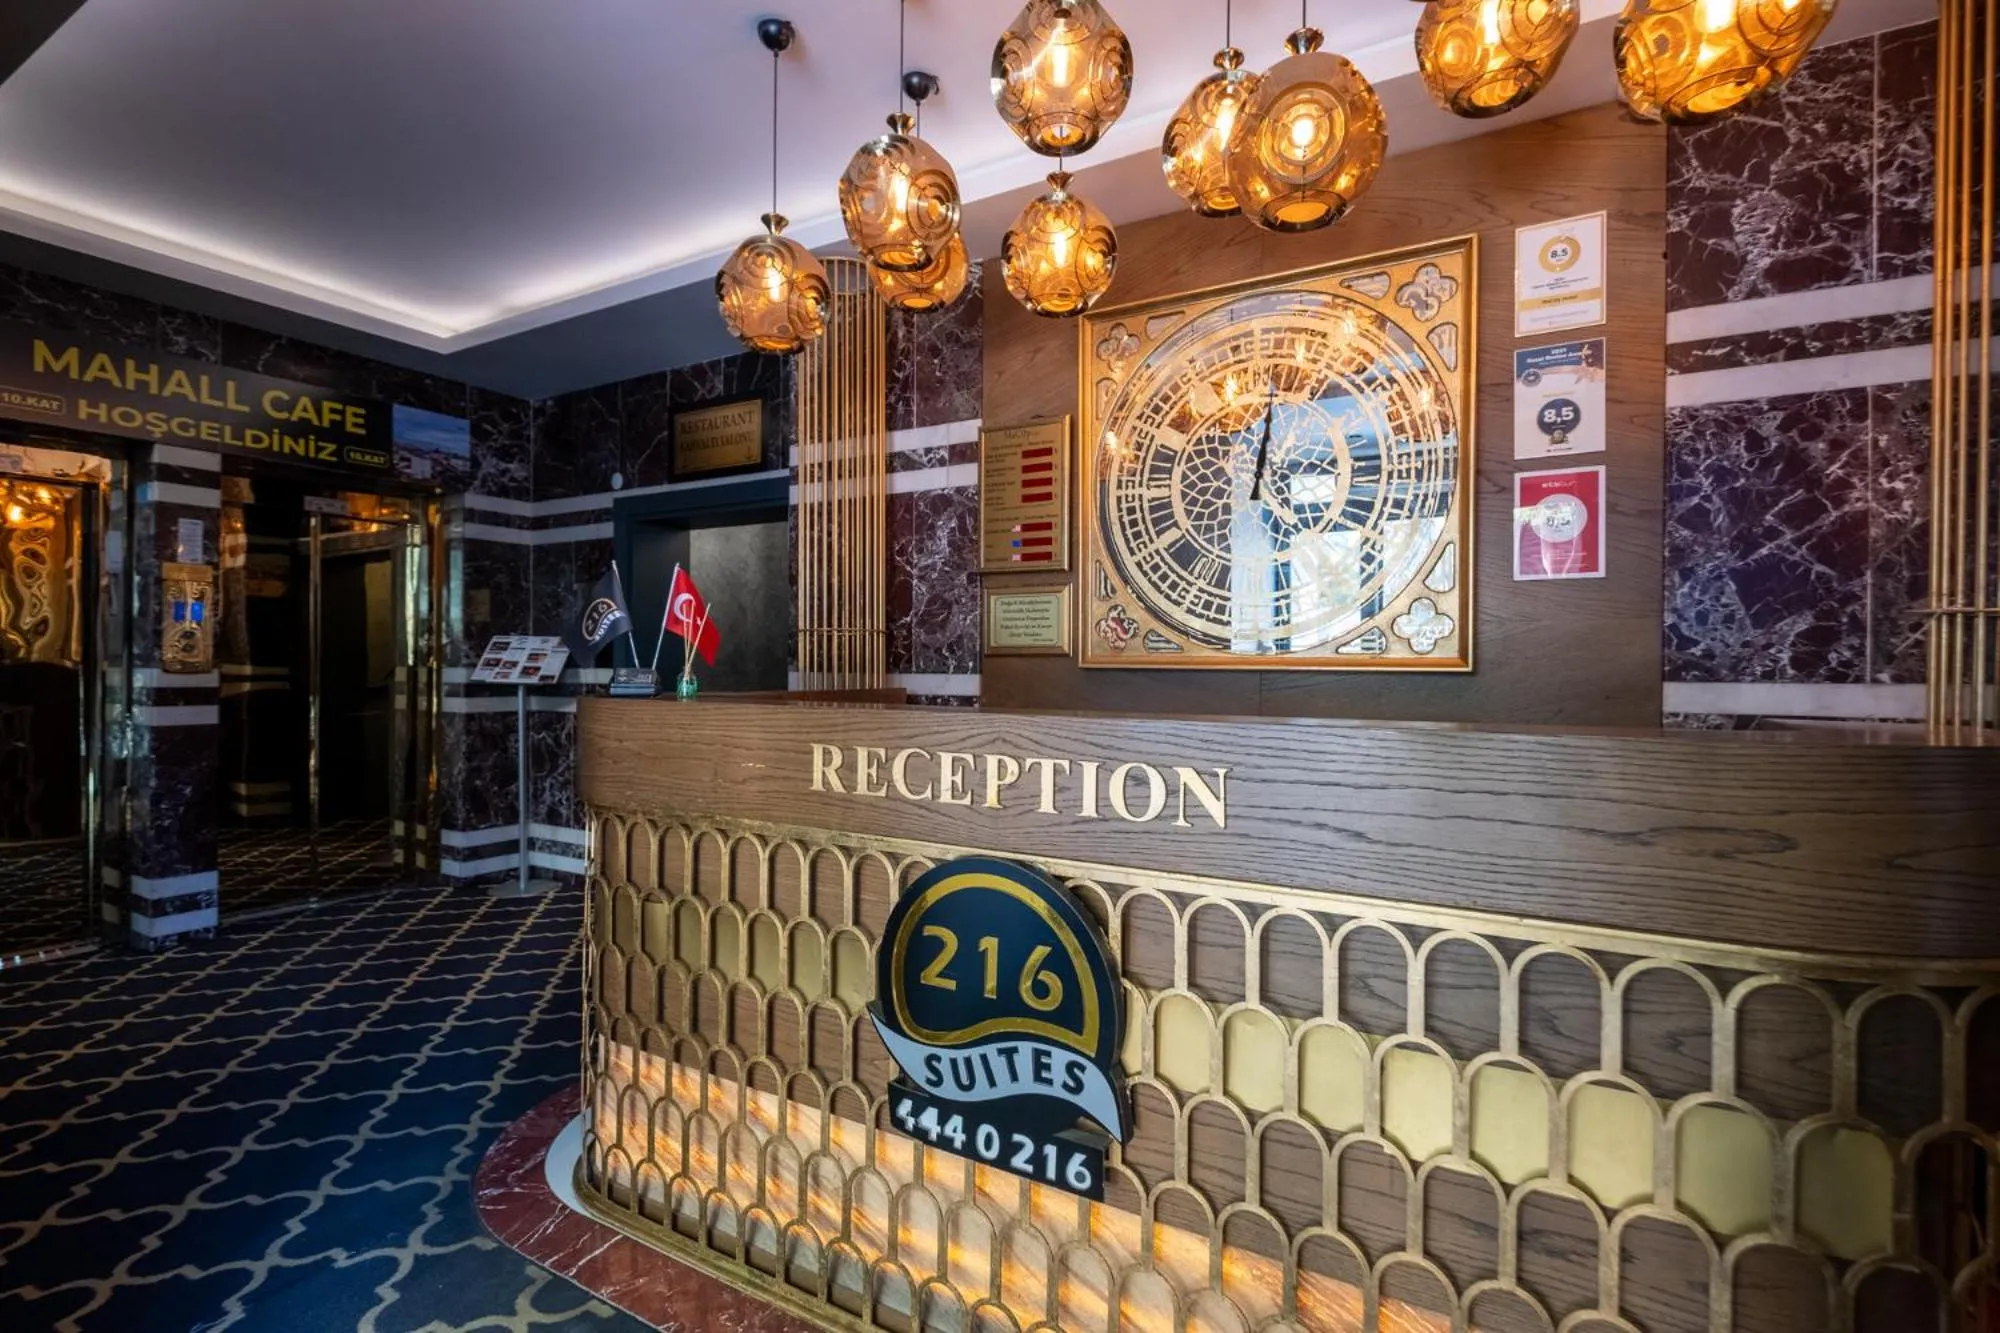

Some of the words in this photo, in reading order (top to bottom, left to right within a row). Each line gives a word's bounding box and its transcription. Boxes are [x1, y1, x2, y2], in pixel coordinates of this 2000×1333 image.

[1, 391, 61, 413] 10.KAT
[32, 338, 250, 414] MAHALL
[261, 389, 367, 436] CAFE
[1543, 406, 1575, 424] 8,5
[76, 399, 339, 463] HOŞGELDİNİZ
[680, 409, 755, 435] RESTAURANT
[809, 742, 1233, 830] RECEPTION
[919, 925, 1064, 1012] 216
[923, 1044, 1088, 1096] SUITES
